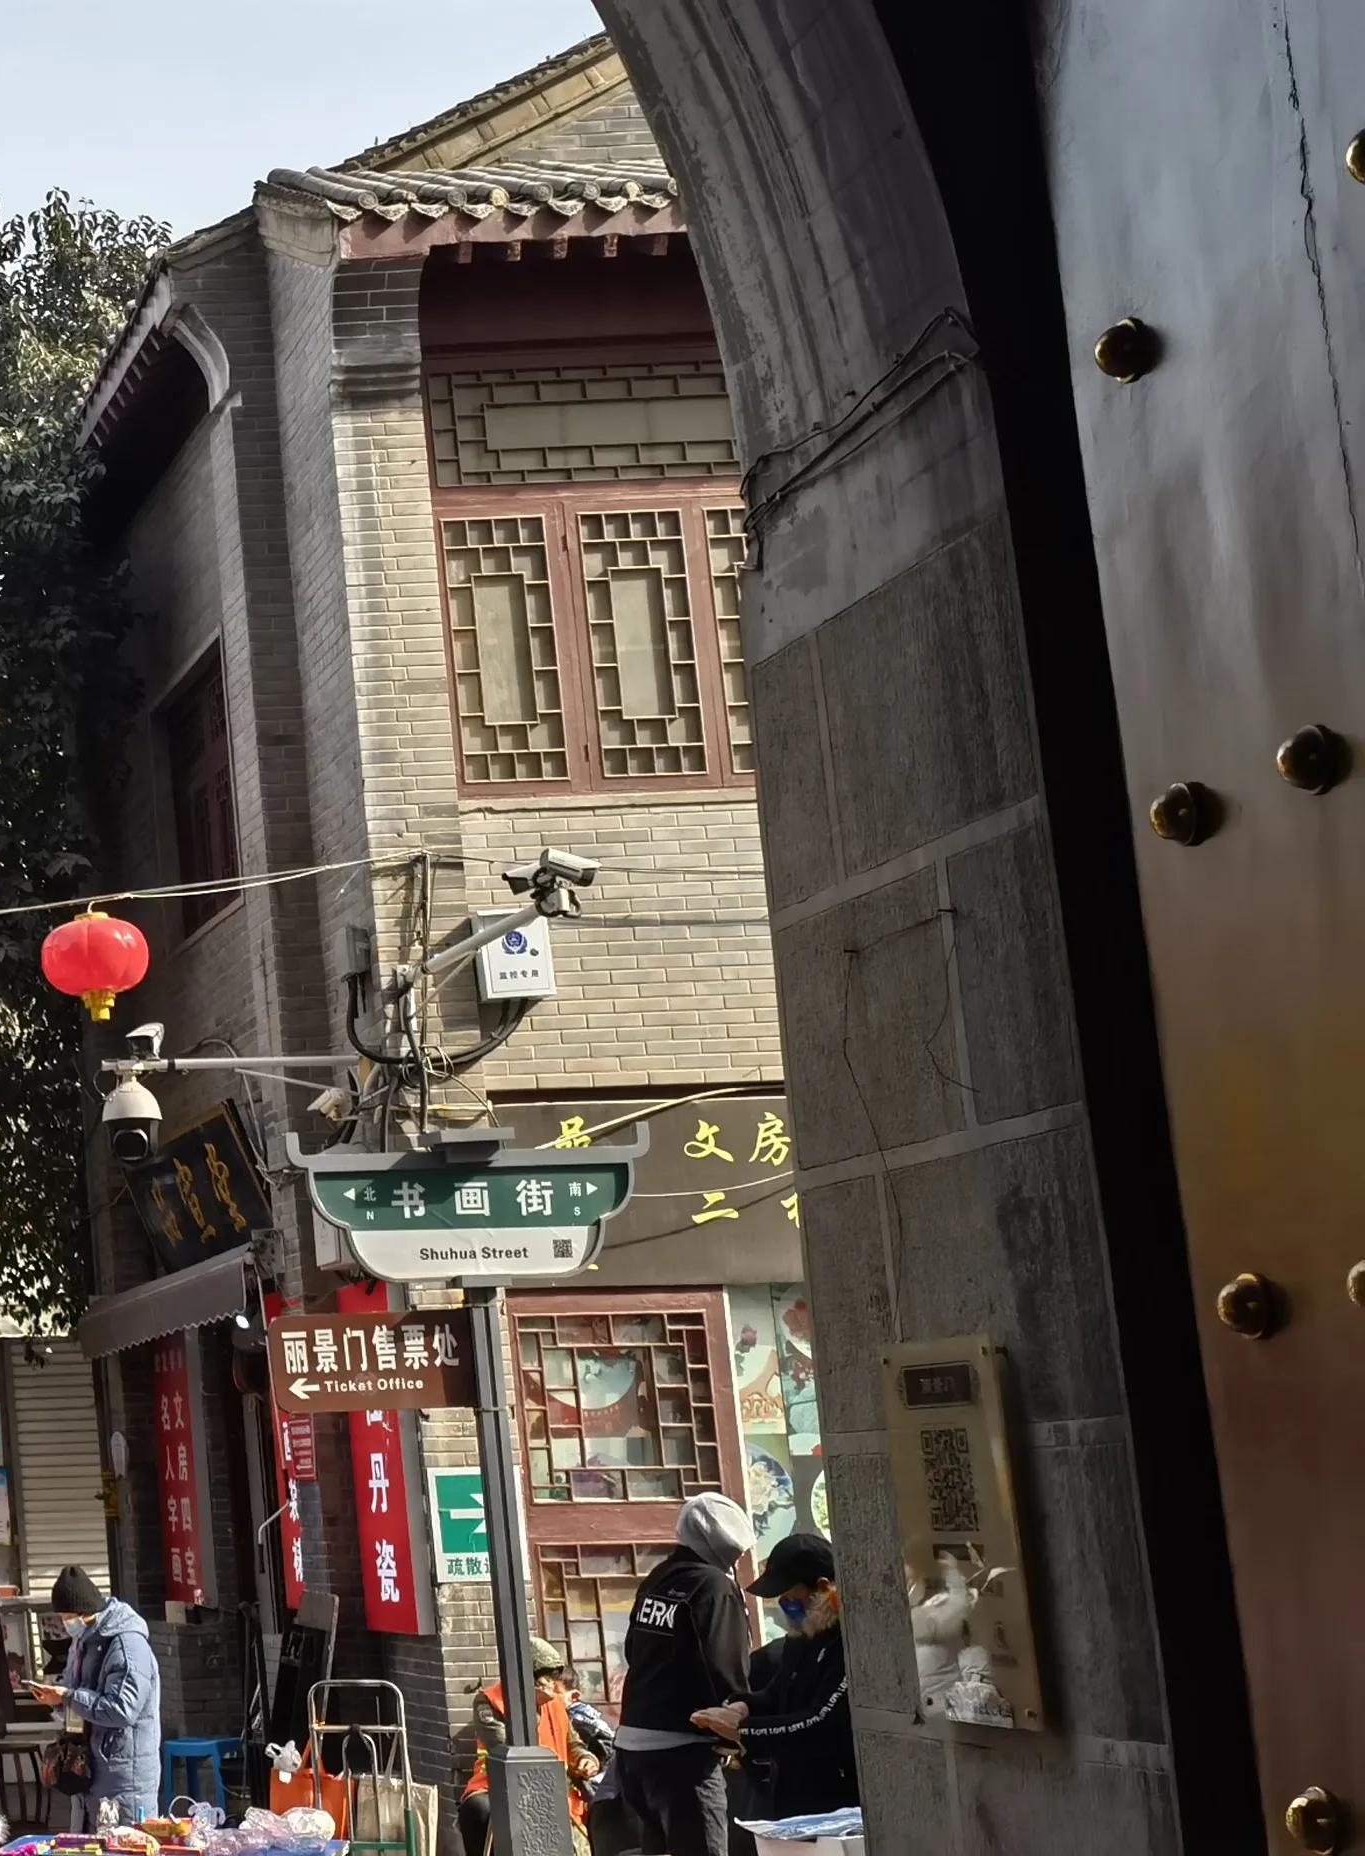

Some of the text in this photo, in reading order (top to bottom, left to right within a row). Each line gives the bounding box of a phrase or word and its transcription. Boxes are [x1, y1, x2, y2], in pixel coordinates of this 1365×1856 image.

[498, 968, 540, 981] 监控专用
[683, 1111, 792, 1167] 文房
[363, 1186, 377, 1203] 北
[568, 1181, 582, 1198] 南
[390, 1178, 555, 1220] 书画街
[365, 1210, 375, 1221] N
[573, 1205, 582, 1217] S
[419, 1246, 529, 1260] Shuhua Street
[281, 1323, 460, 1374] 丽景门售票处
[324, 1377, 424, 1393] Ticket Office
[160, 1393, 183, 1585] 名人字画
[172, 1390, 197, 1586] 文房四宝
